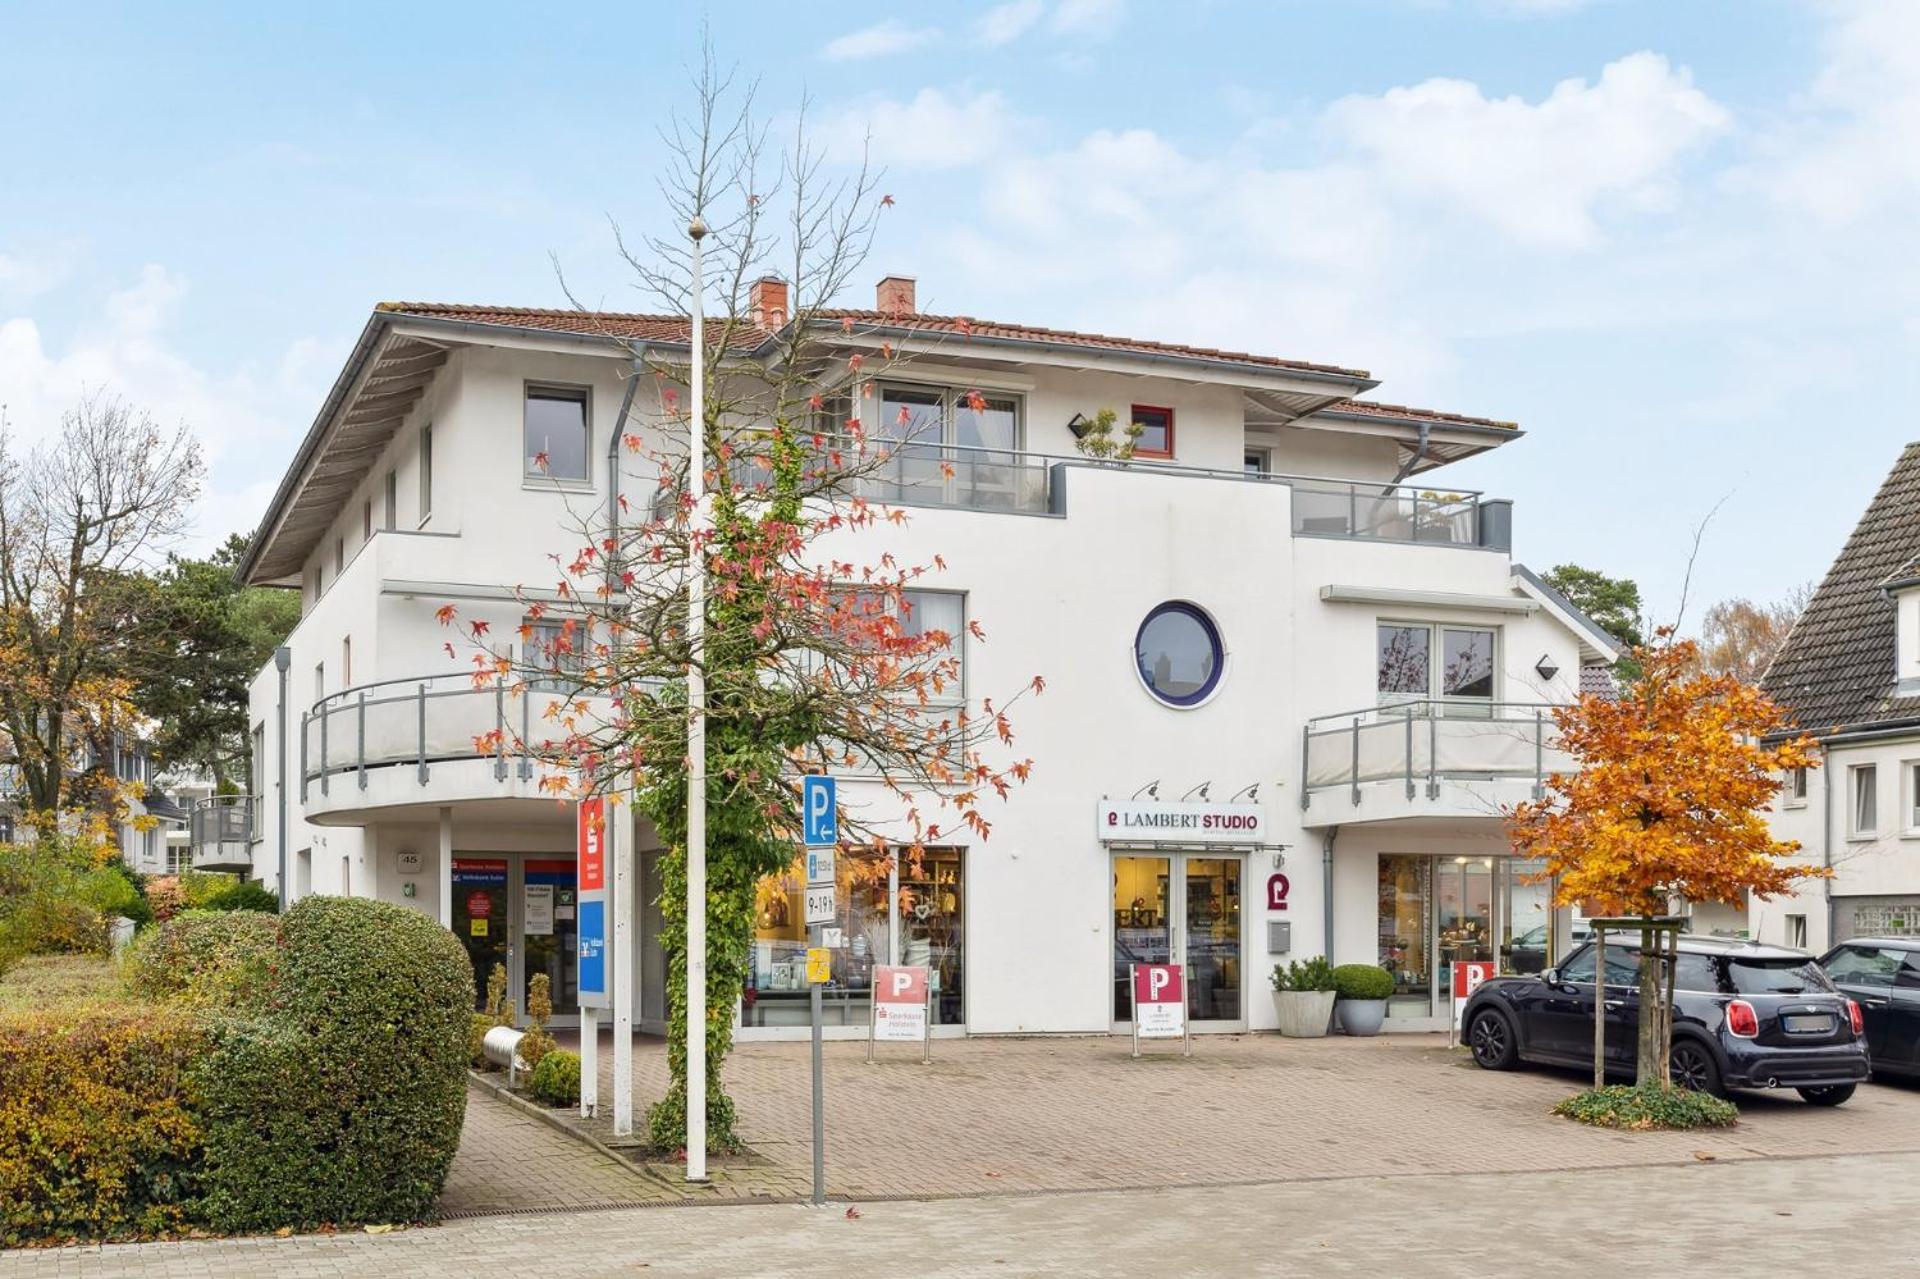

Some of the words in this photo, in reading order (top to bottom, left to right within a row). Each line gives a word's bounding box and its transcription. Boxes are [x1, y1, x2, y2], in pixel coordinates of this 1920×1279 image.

[811, 784, 829, 836] P
[1124, 812, 1200, 829] LAMBERT
[1202, 814, 1258, 830] STUDIO
[892, 972, 913, 997] P
[1150, 967, 1169, 1001] P
[1467, 964, 1485, 996] P
